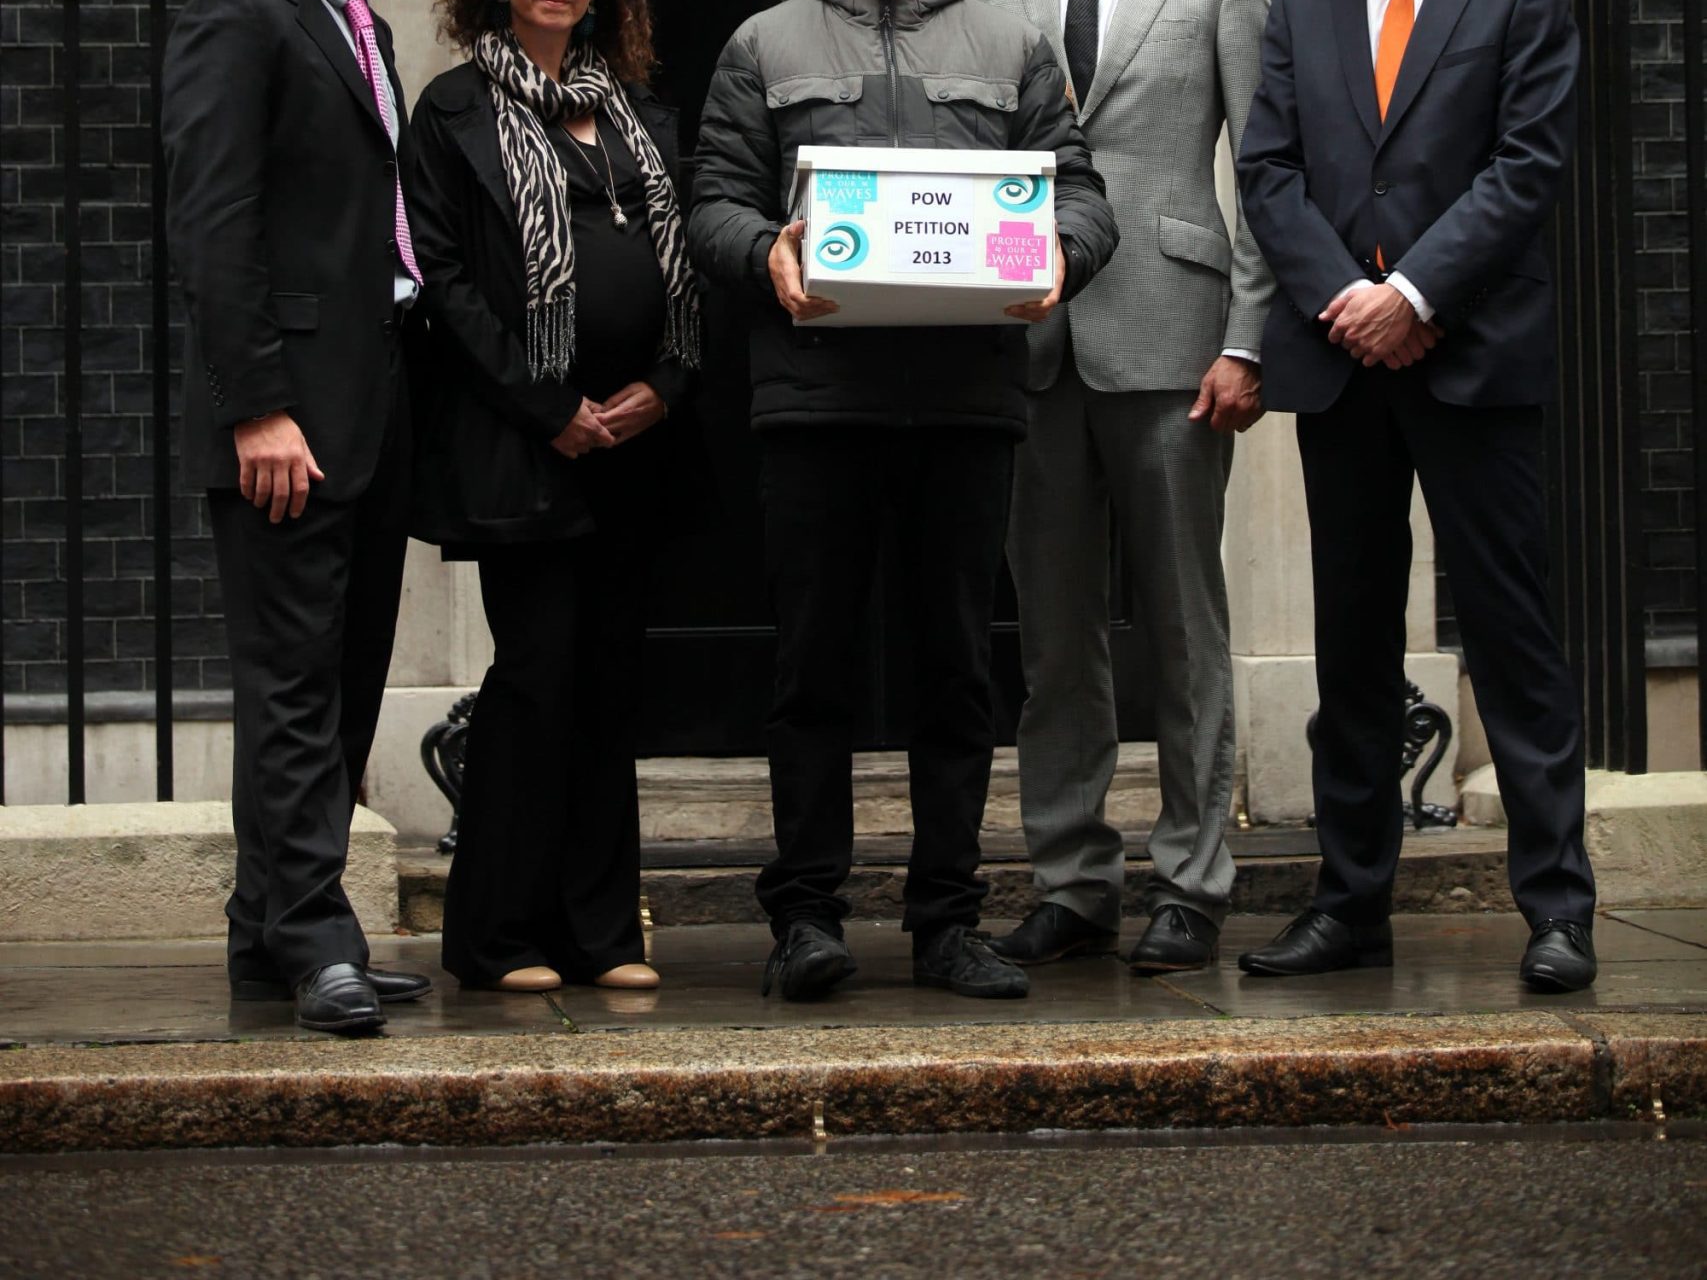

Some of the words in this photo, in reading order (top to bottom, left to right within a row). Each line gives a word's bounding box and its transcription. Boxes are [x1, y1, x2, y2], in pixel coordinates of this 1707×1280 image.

[821, 188, 873, 200] WAVES
[911, 192, 953, 206] POW
[894, 221, 970, 235] PETITION
[991, 236, 1042, 247] PROTECT
[1007, 246, 1026, 254] OUR
[912, 250, 953, 265] 2013
[991, 254, 1041, 267] WAVES
